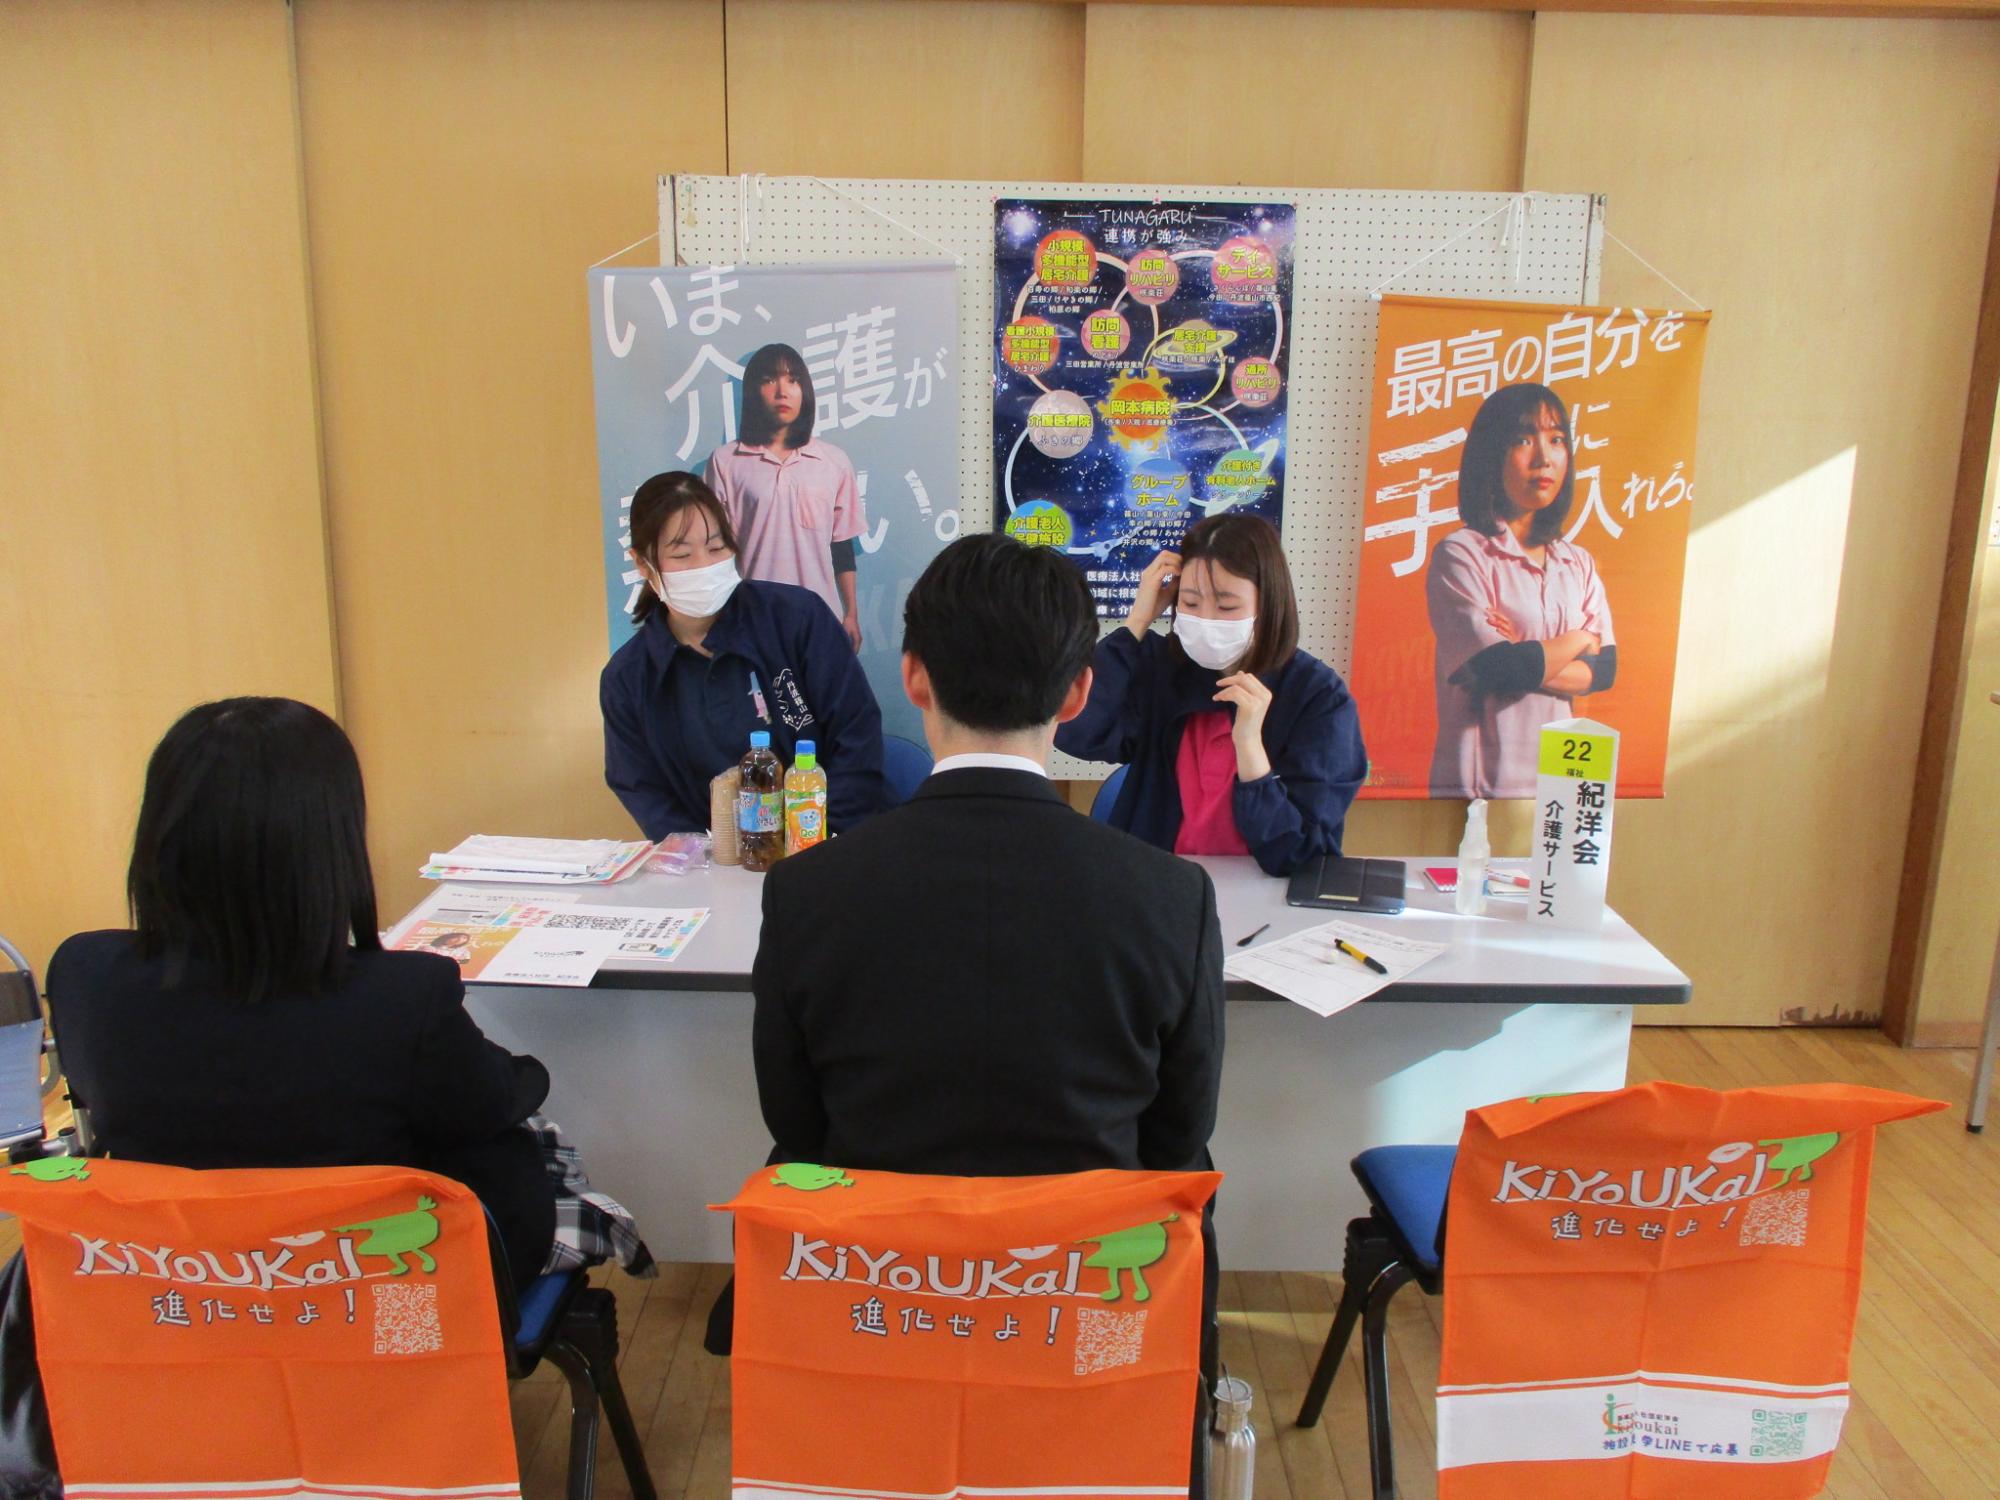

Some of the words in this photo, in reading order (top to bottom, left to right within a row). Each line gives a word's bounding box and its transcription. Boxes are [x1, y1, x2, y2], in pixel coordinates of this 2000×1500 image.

[1098, 208, 1193, 227] TUNAGARU
[1103, 227, 1189, 245] 連携が強み
[1140, 258, 1166, 271] 訪問
[1216, 263, 1275, 279] サービス
[1040, 268, 1090, 281] 居宅介護
[1129, 272, 1176, 286] リハビリ
[603, 264, 772, 358] いま、
[1091, 317, 1121, 332] 訪問
[1091, 334, 1121, 350] 看護
[1174, 329, 1218, 341] 居宅介護
[1183, 342, 1207, 353] 支援
[1245, 364, 1268, 375] 通所
[1386, 306, 1686, 419] 最高の自分を
[664, 305, 948, 461] 介護が
[1235, 377, 1278, 389] リハビリ
[1111, 399, 1171, 415] 岡本病院
[1029, 413, 1092, 427] 介護医療院
[1222, 460, 1261, 471] 介護付き
[1131, 474, 1188, 490] グループ
[1136, 491, 1180, 507] ホーム
[1014, 516, 1065, 531] 介護老人
[1086, 570, 1144, 582] 医療法人社
[1562, 738, 1593, 762] 22
[1566, 767, 1584, 778] 福祉
[1572, 780, 1606, 866] 紀洋会
[800, 828, 819, 838] Qoo
[1537, 799, 1564, 918] 介護サービス
